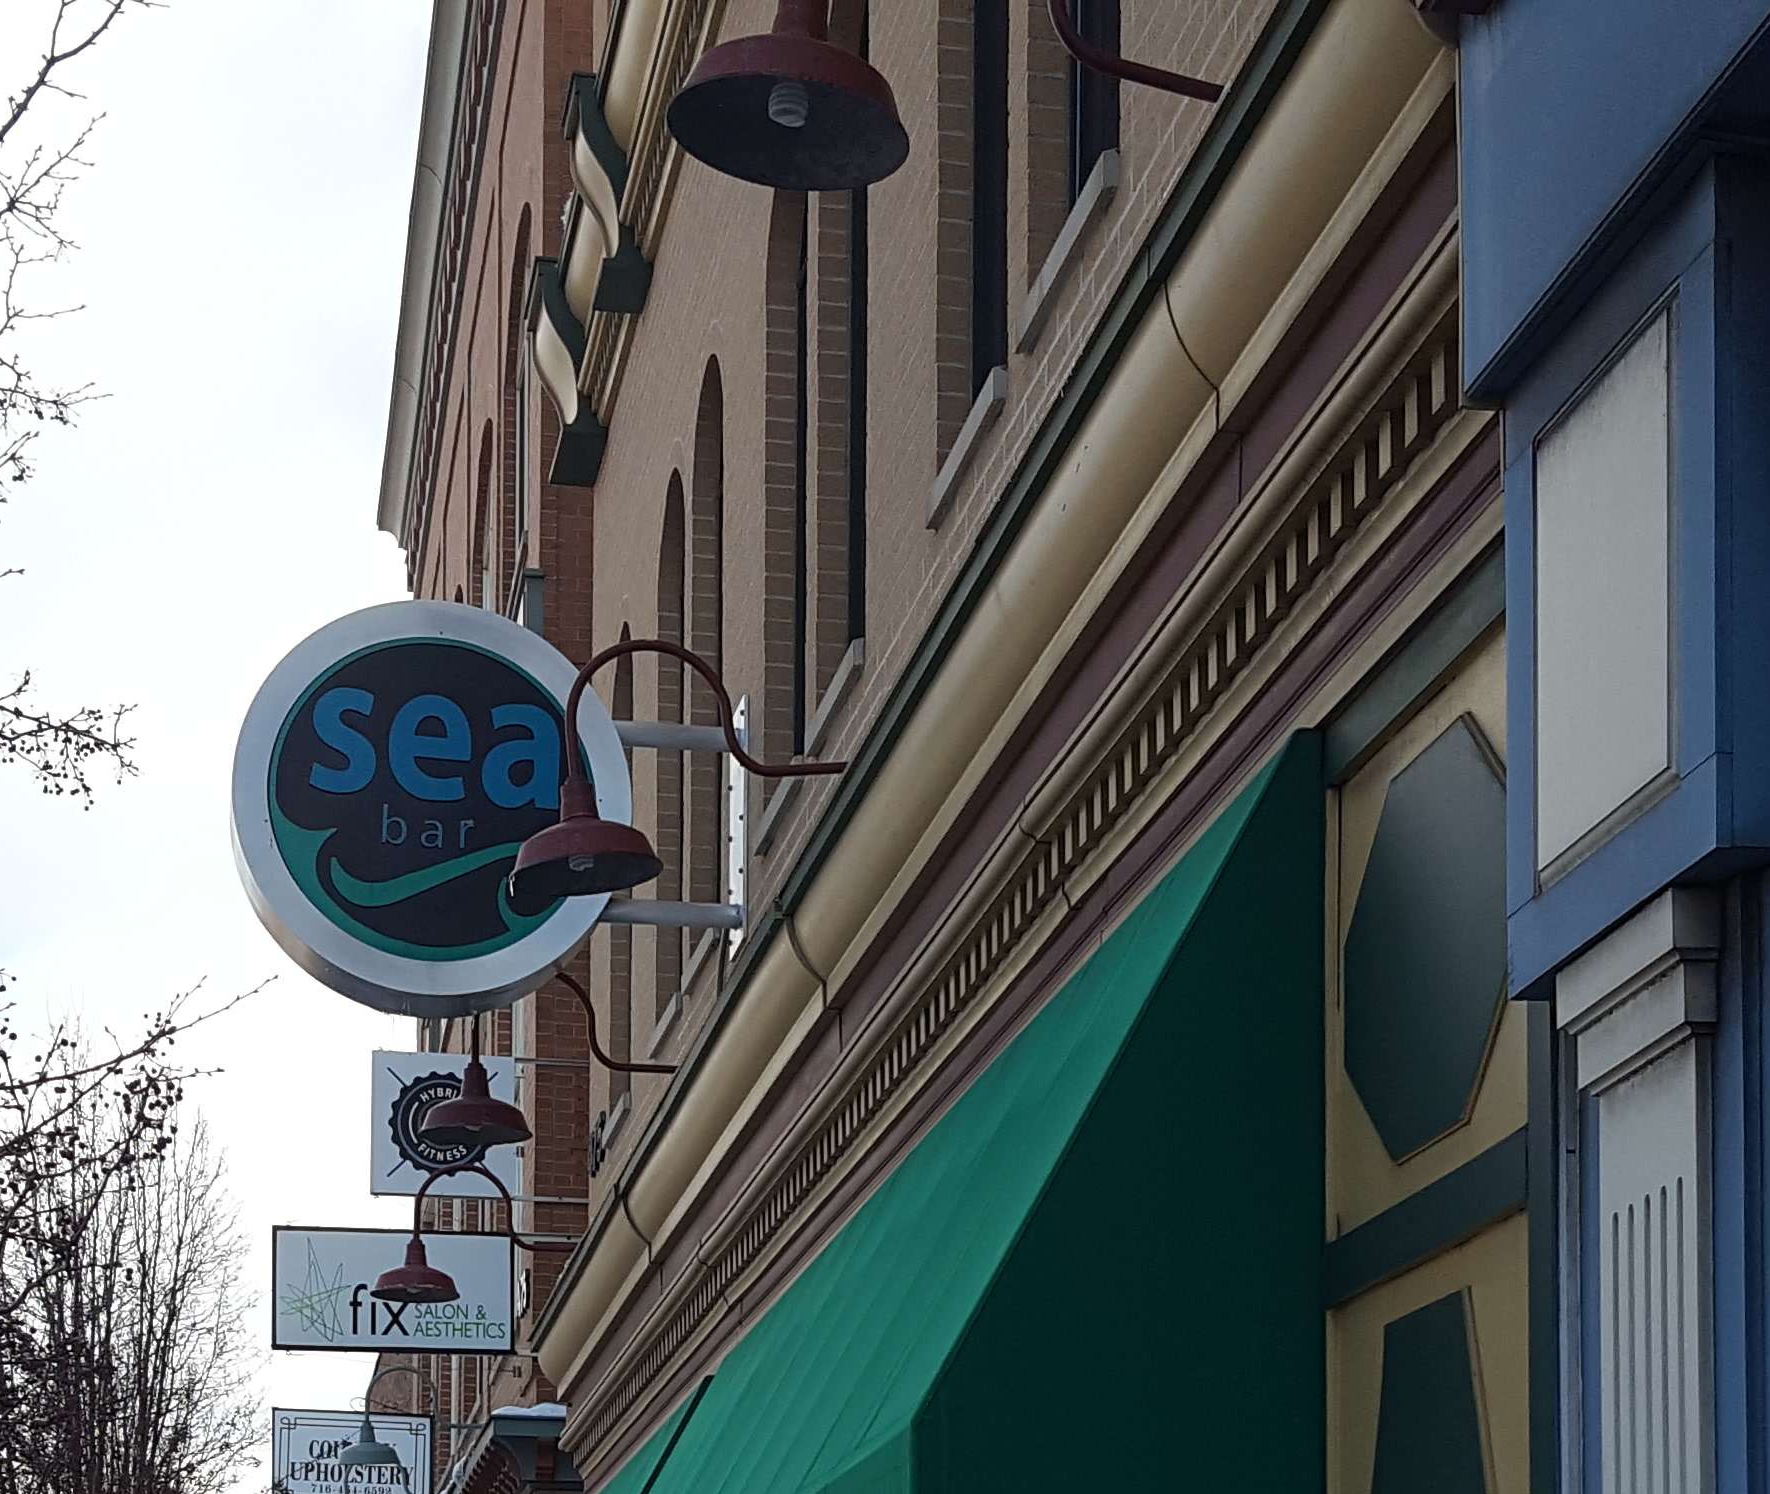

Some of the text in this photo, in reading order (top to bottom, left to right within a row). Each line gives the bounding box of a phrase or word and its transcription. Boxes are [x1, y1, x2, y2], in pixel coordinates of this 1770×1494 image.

[309, 687, 561, 810] sea
[381, 803, 475, 849] bar
[419, 1087, 459, 1103] HYBRI
[417, 1142, 468, 1161] FITNESS
[349, 1283, 410, 1336] fix
[414, 1303, 488, 1320] SALON &
[413, 1321, 506, 1339] AESTHETICS
